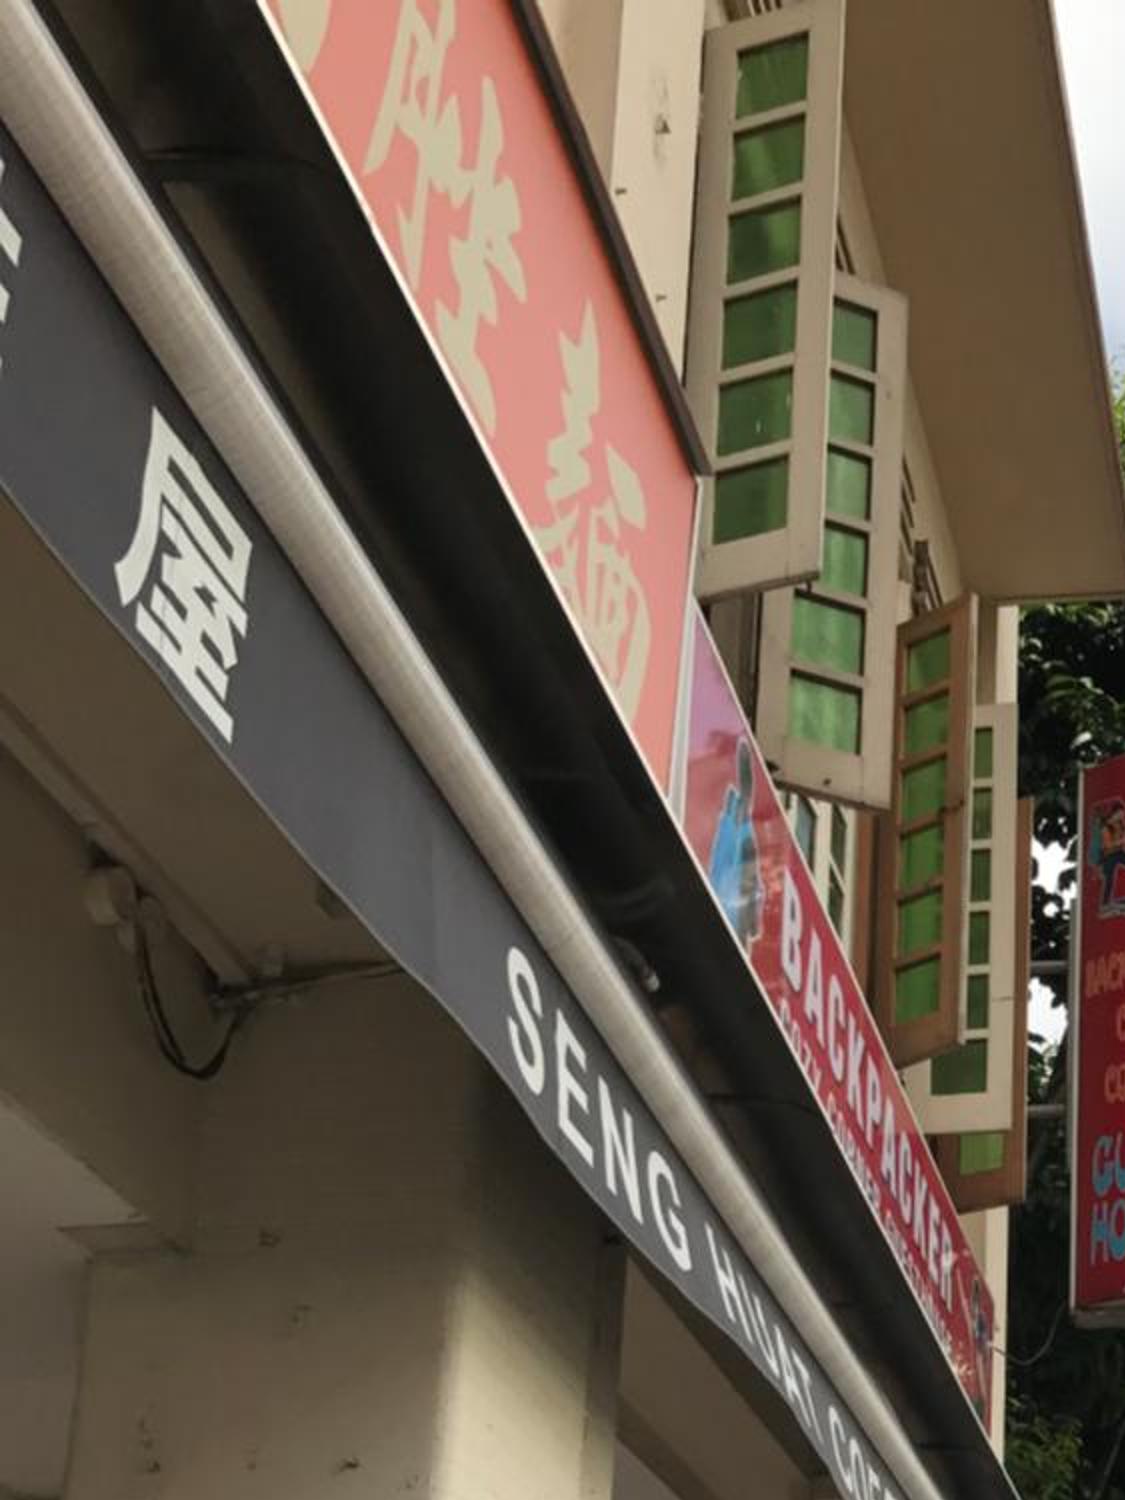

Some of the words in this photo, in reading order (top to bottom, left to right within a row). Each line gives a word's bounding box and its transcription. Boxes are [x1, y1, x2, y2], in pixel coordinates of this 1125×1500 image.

[506, 945, 693, 1272] SENG
[705, 1221, 824, 1445] HUAT
[780, 864, 956, 1314] BACKPACKER
